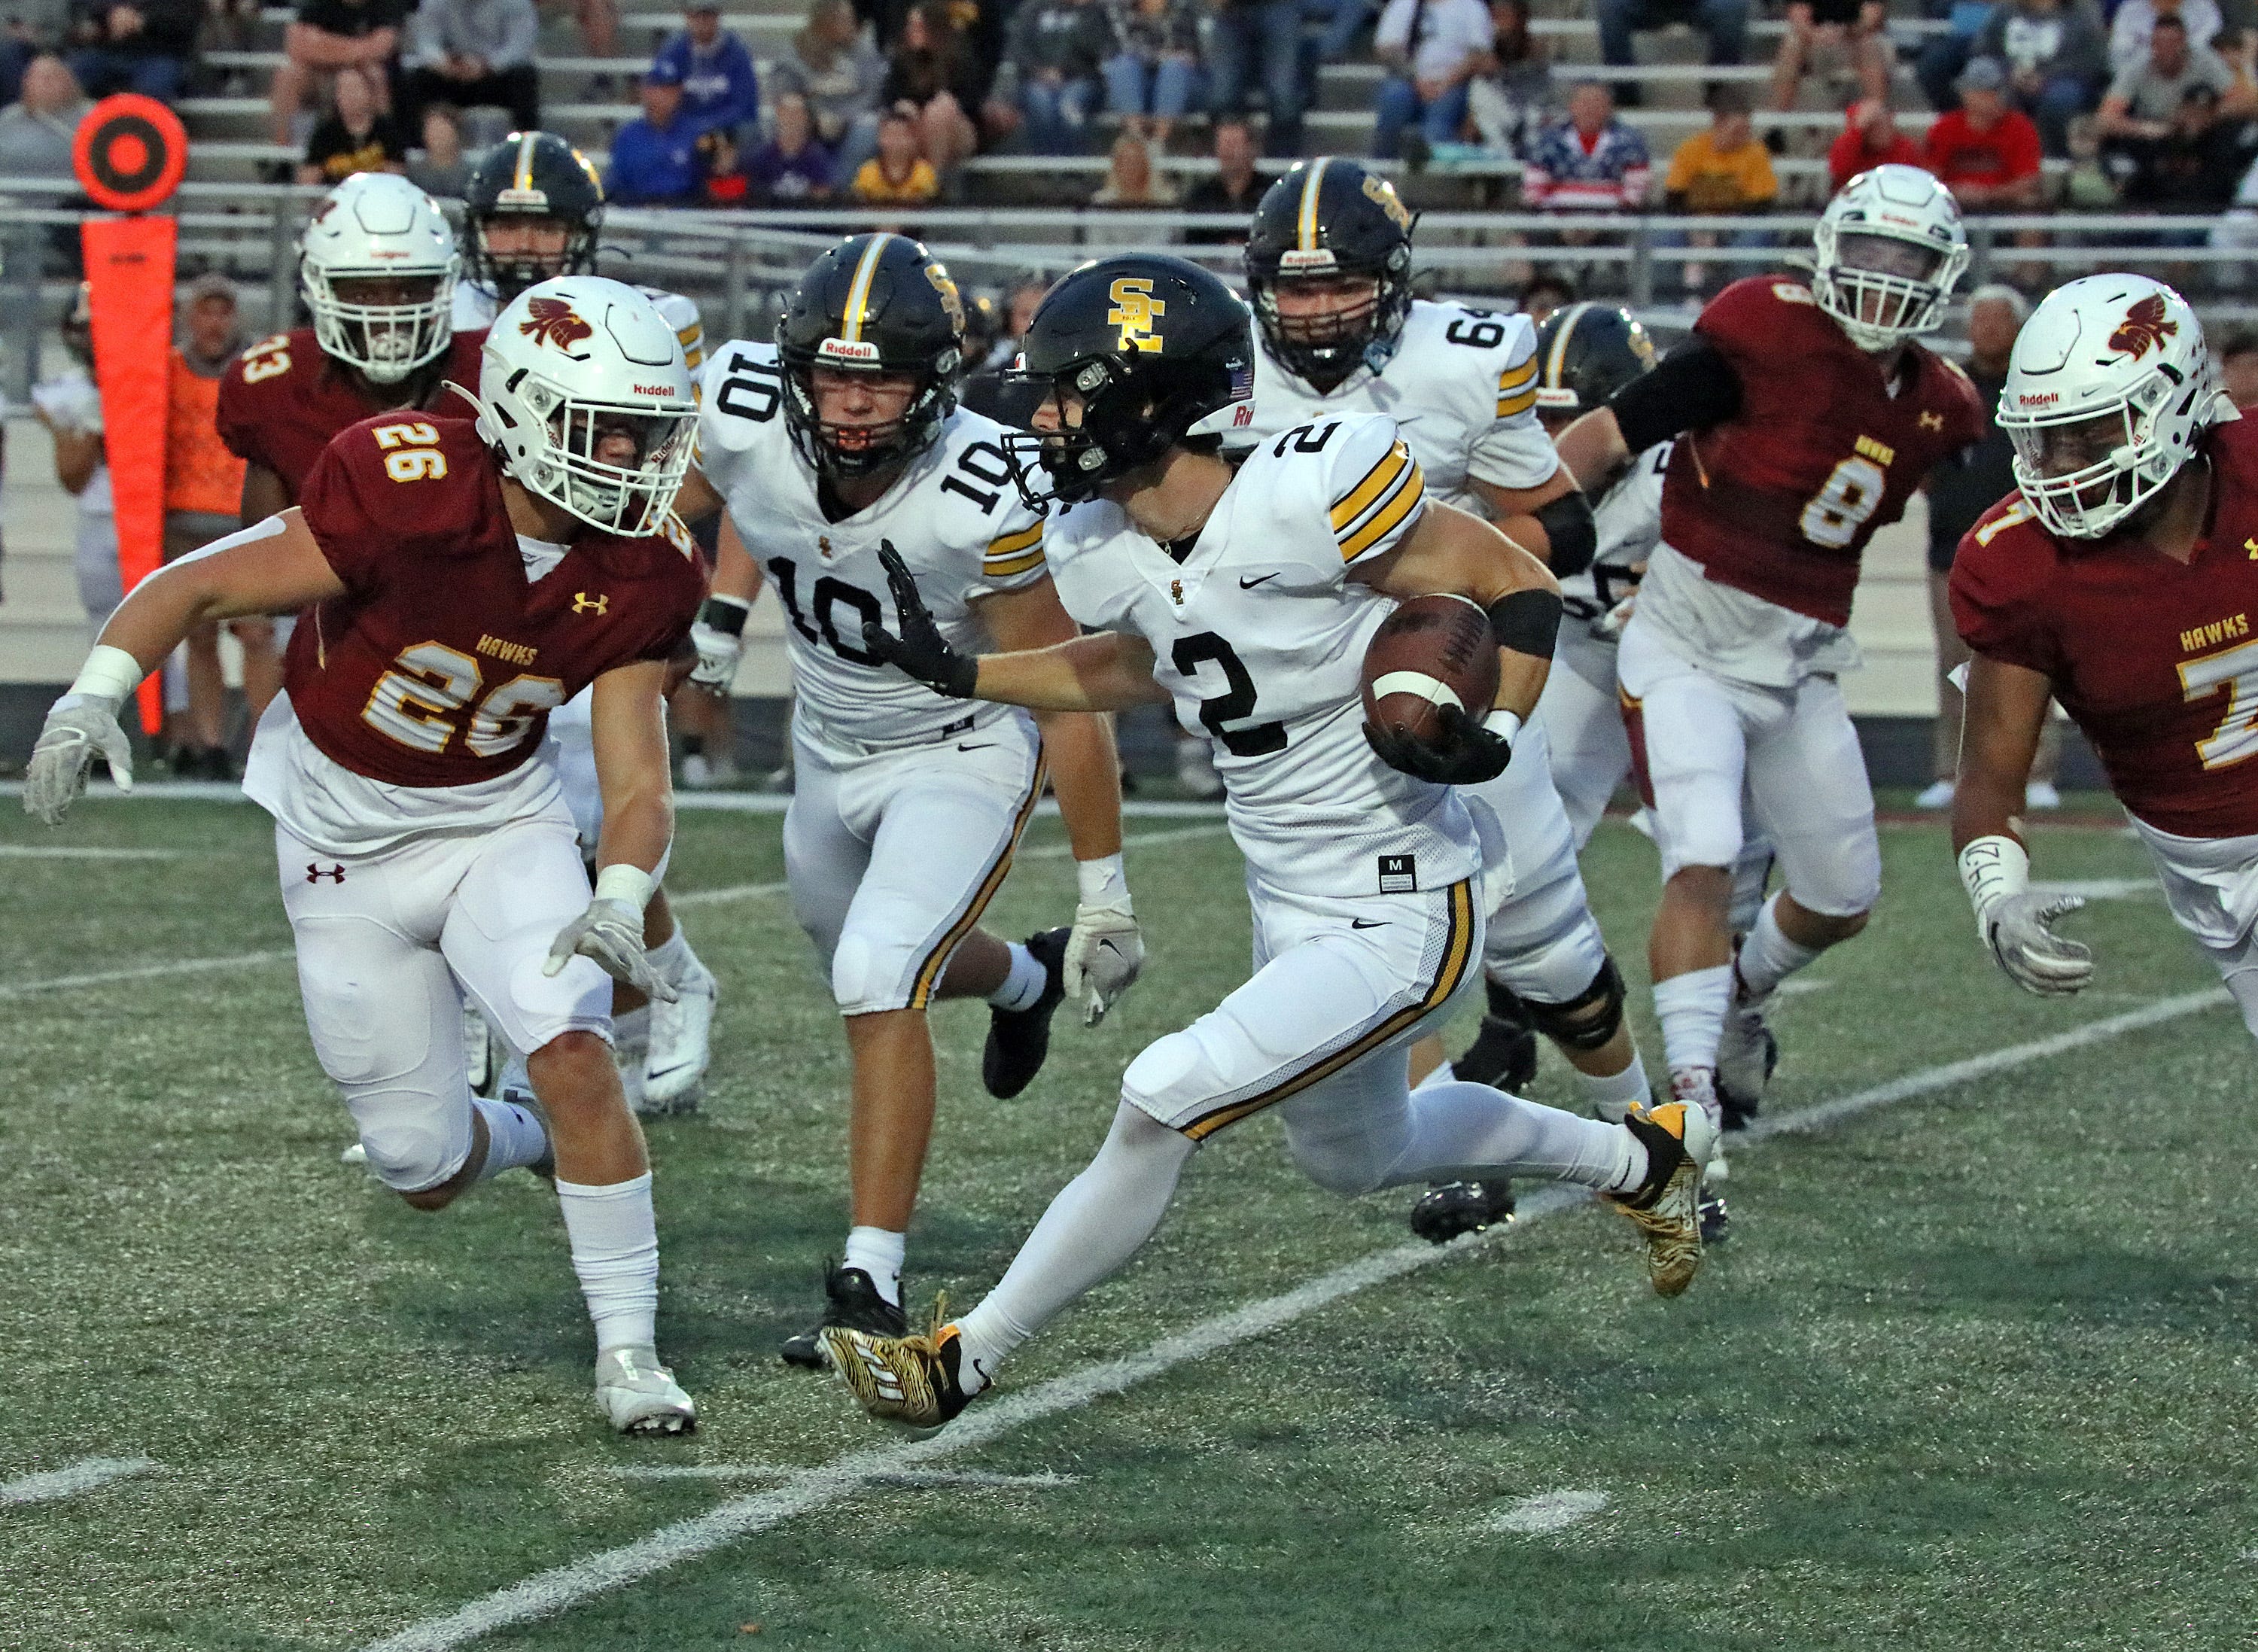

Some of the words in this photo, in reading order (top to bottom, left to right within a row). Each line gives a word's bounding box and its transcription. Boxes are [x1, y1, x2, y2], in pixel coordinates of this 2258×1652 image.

[826, 342, 872, 357] Riddell
[1445, 307, 1505, 349] 6
[633, 384, 675, 397] Riddell
[717, 352, 783, 423] 10
[2019, 392, 2059, 406] Riddell
[371, 422, 448, 483] 26
[1273, 421, 1343, 458] 2
[940, 441, 1021, 516] 10
[1800, 455, 1885, 549] 8
[768, 555, 885, 668] 10
[2180, 613, 2250, 653] HAWKS
[476, 633, 539, 667] HAWKS
[360, 640, 567, 759] 26
[1171, 631, 1289, 757] 2
[2175, 637, 2258, 771] 7
[1389, 859, 1402, 871] M
